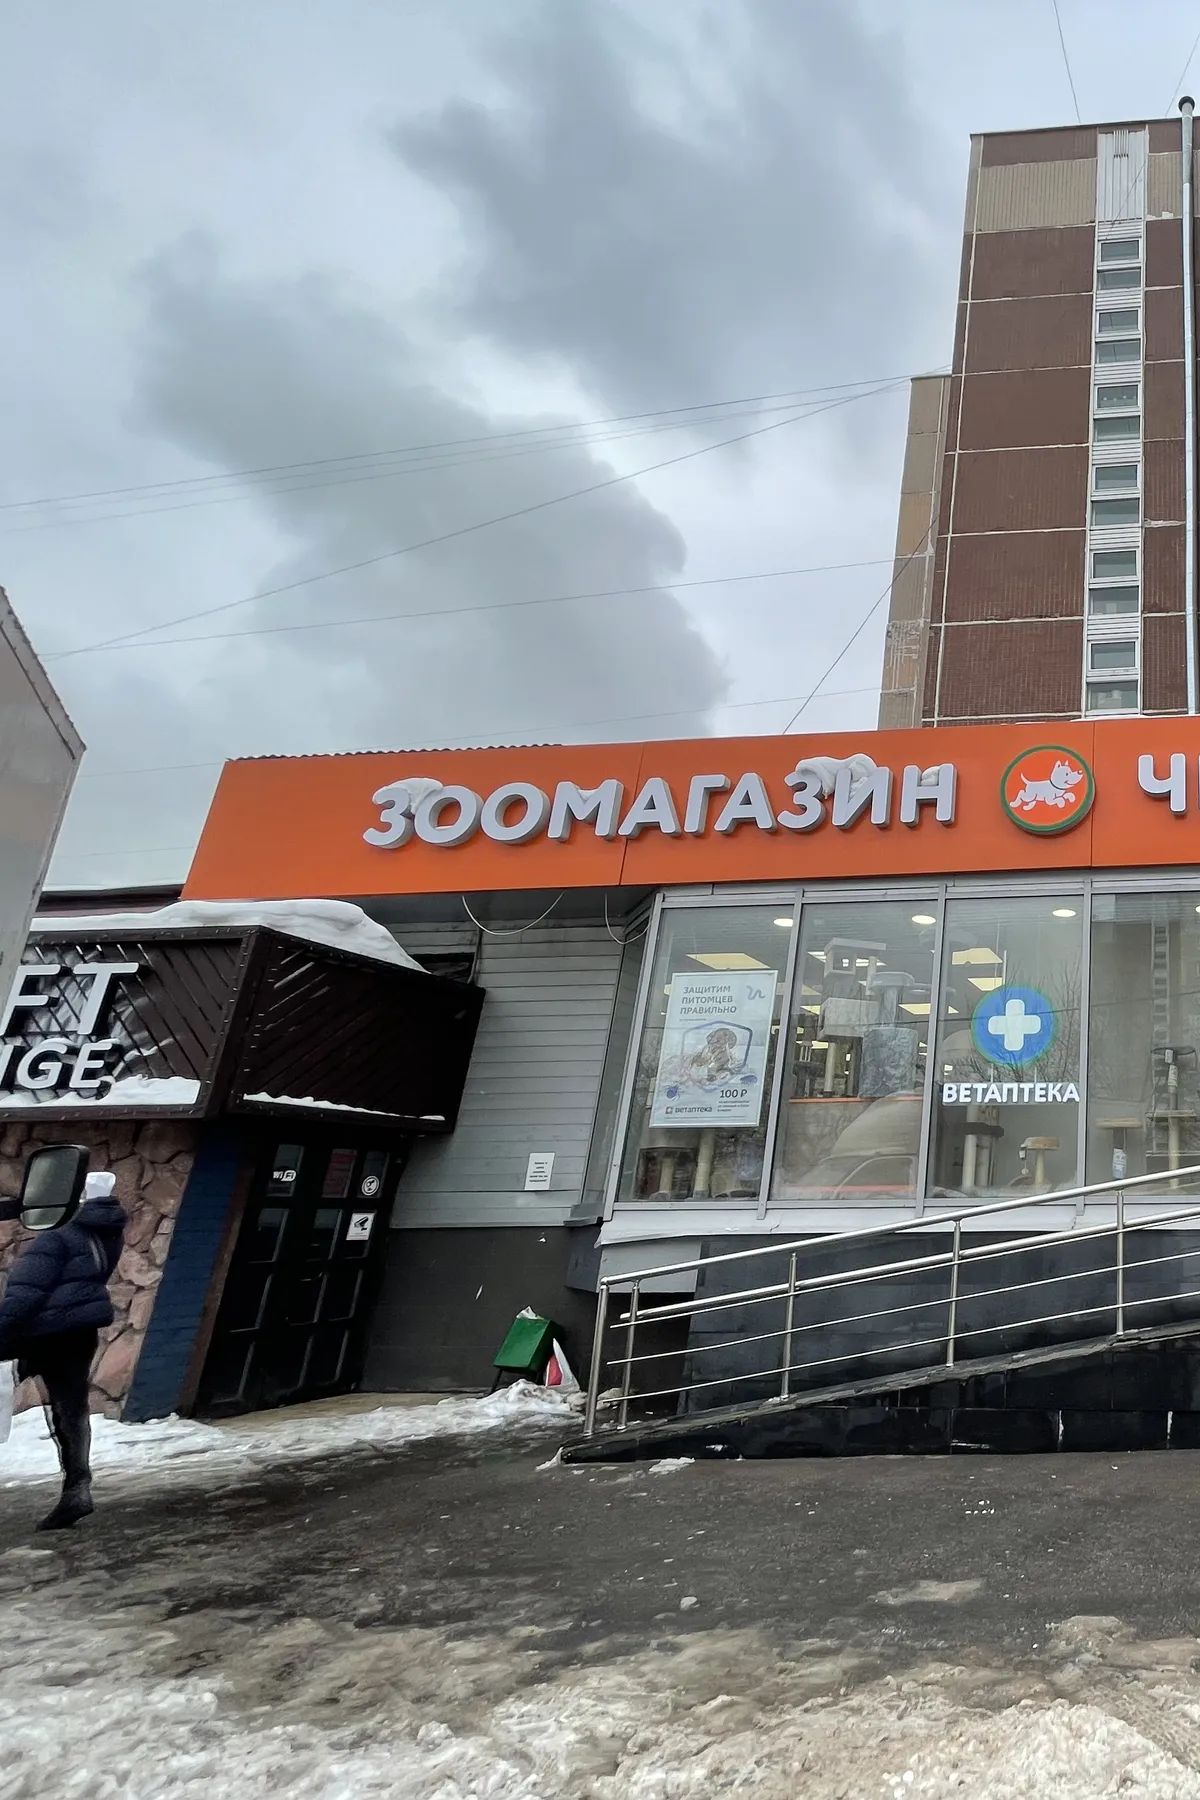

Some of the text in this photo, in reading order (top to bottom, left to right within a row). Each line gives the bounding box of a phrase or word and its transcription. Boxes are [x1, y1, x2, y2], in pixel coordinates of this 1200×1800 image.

[362, 762, 958, 849] ЗООМАГАЗИН
[683, 985, 731, 995] ЗАЩИТИМ
[681, 995, 733, 1005] ПИТОМЦЕВ
[680, 1005, 737, 1015] ПРАВИЛЬНО
[720, 1088, 739, 1099] 100
[942, 1082, 1080, 1103] ВЕТАПТЕКА
